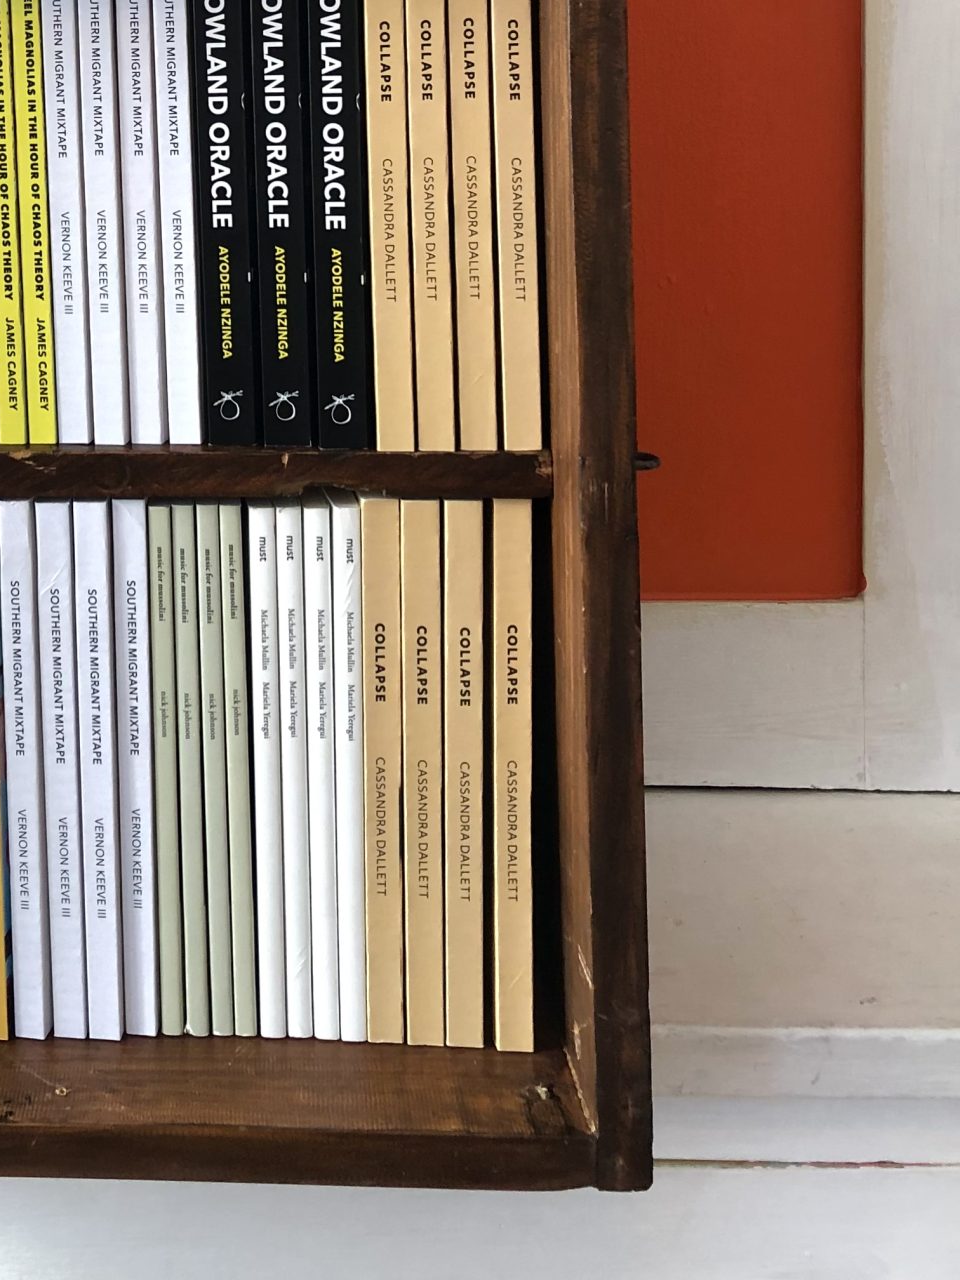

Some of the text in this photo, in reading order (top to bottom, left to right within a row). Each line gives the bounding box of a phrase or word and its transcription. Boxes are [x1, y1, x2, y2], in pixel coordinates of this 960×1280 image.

[24, 19, 35, 95] MAGNOLIAS
[166, 47, 177, 101] MIGRANT
[27, 99, 36, 112] IN
[28, 115, 37, 139] THE
[168, 105, 179, 155] MIXTAPE
[29, 143, 39, 178] HOUR
[322, 123, 345, 229] ORACLE
[507, 19, 525, 302] COLLAPSE CASSANDRA DALLETT
[30, 183, 40, 199] OF
[31, 203, 42, 246] CHAOS
[172, 209, 182, 259] VERNON
[33, 249, 44, 300] THEORY
[174, 263, 184, 299] KEEVE
[331, 248, 342, 306] AYODELE
[175, 303, 184, 313] III
[36, 317, 46, 357] JAMES
[332, 311, 344, 362] NZINGA
[38, 361, 48, 410] CAGNEY
[416, 625, 428, 898] COLLAPSE CASSANDRA DALLETT
